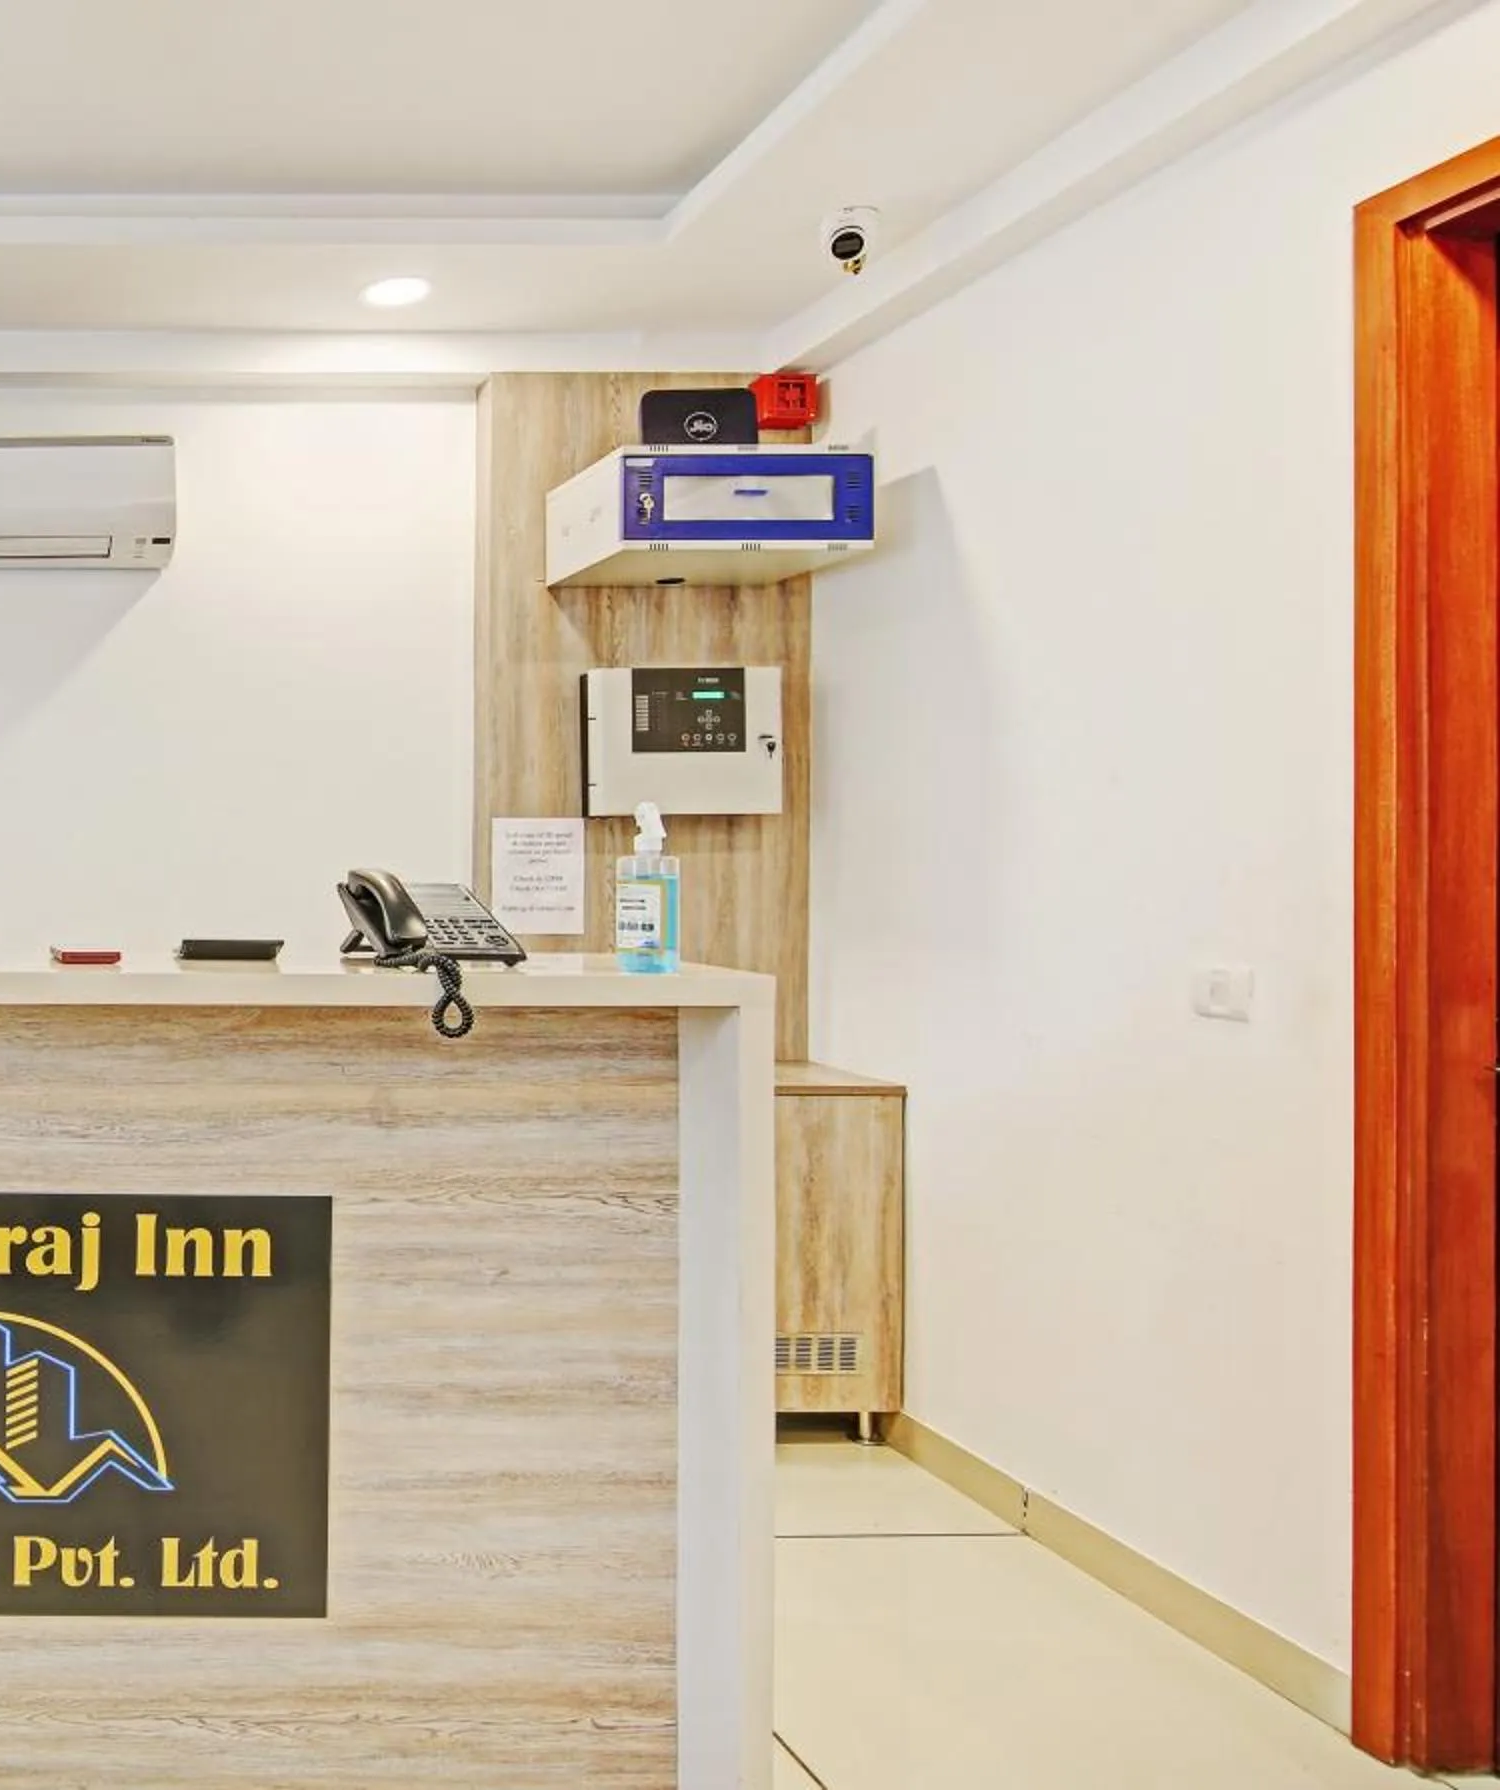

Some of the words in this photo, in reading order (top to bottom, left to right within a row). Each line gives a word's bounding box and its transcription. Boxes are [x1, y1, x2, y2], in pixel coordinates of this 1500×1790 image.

[690, 419, 713, 432] Jio
[135, 1213, 272, 1277] Inn
[13, 1536, 134, 1589] Pvt.
[162, 1538, 280, 1589] Ltd.
